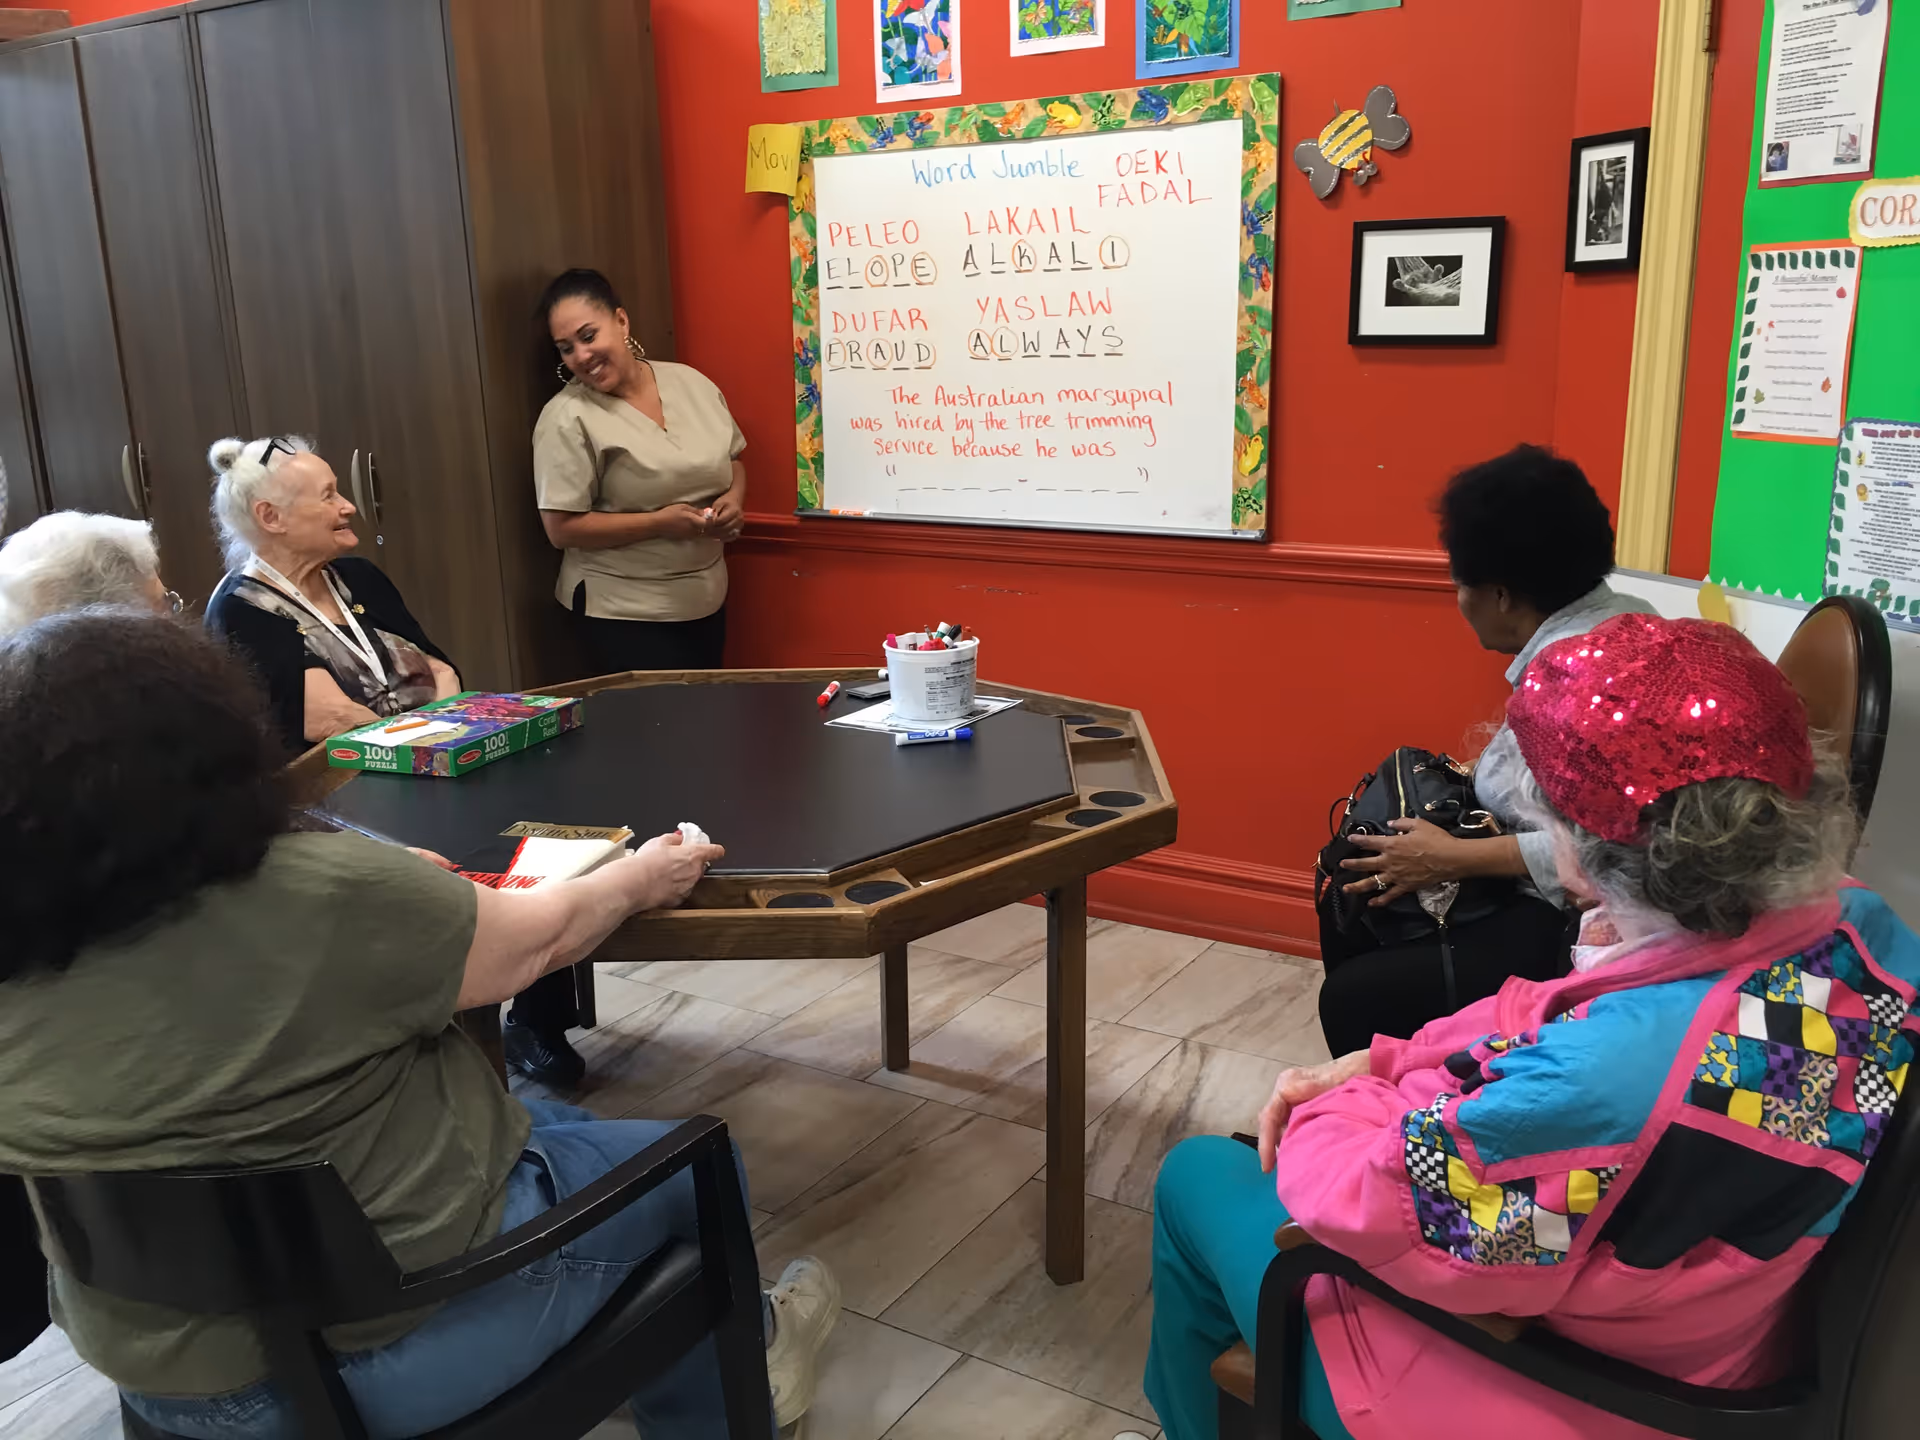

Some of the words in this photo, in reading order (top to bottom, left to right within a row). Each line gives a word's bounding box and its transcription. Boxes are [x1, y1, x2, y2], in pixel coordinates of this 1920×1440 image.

[912, 153, 976, 187] Word
[993, 149, 1084, 179] Jumble
[1115, 149, 1184, 177] OEKI
[1098, 179, 1212, 207] FADAL
[964, 206, 1091, 235] LAKAIL
[1860, 193, 1920, 228] COR
[828, 219, 919, 248] PELEO
[826, 252, 934, 282] ELOPE
[963, 240, 1118, 271] ALKALI
[976, 287, 1112, 324] YASLAW
[832, 308, 928, 334] DUFAR
[827, 339, 933, 364] FRAUD
[972, 325, 1123, 355] ALWAYS
[885, 385, 922, 405] The
[935, 384, 1044, 407] Australian
[1057, 381, 1173, 410] marsupial
[850, 416, 883, 432] was
[895, 411, 944, 432] hired
[955, 412, 975, 445] by
[979, 411, 1008, 431] the
[1016, 410, 1055, 430] tree
[1064, 412, 1157, 447] trimming
[952, 436, 1023, 457] because
[1036, 438, 1058, 458] he
[1072, 441, 1116, 458] was
[364, 745, 393, 761] 100
[484, 733, 506, 753] 100
[484, 746, 511, 762] PUZZLE
[365, 761, 398, 770] PUZZLE
